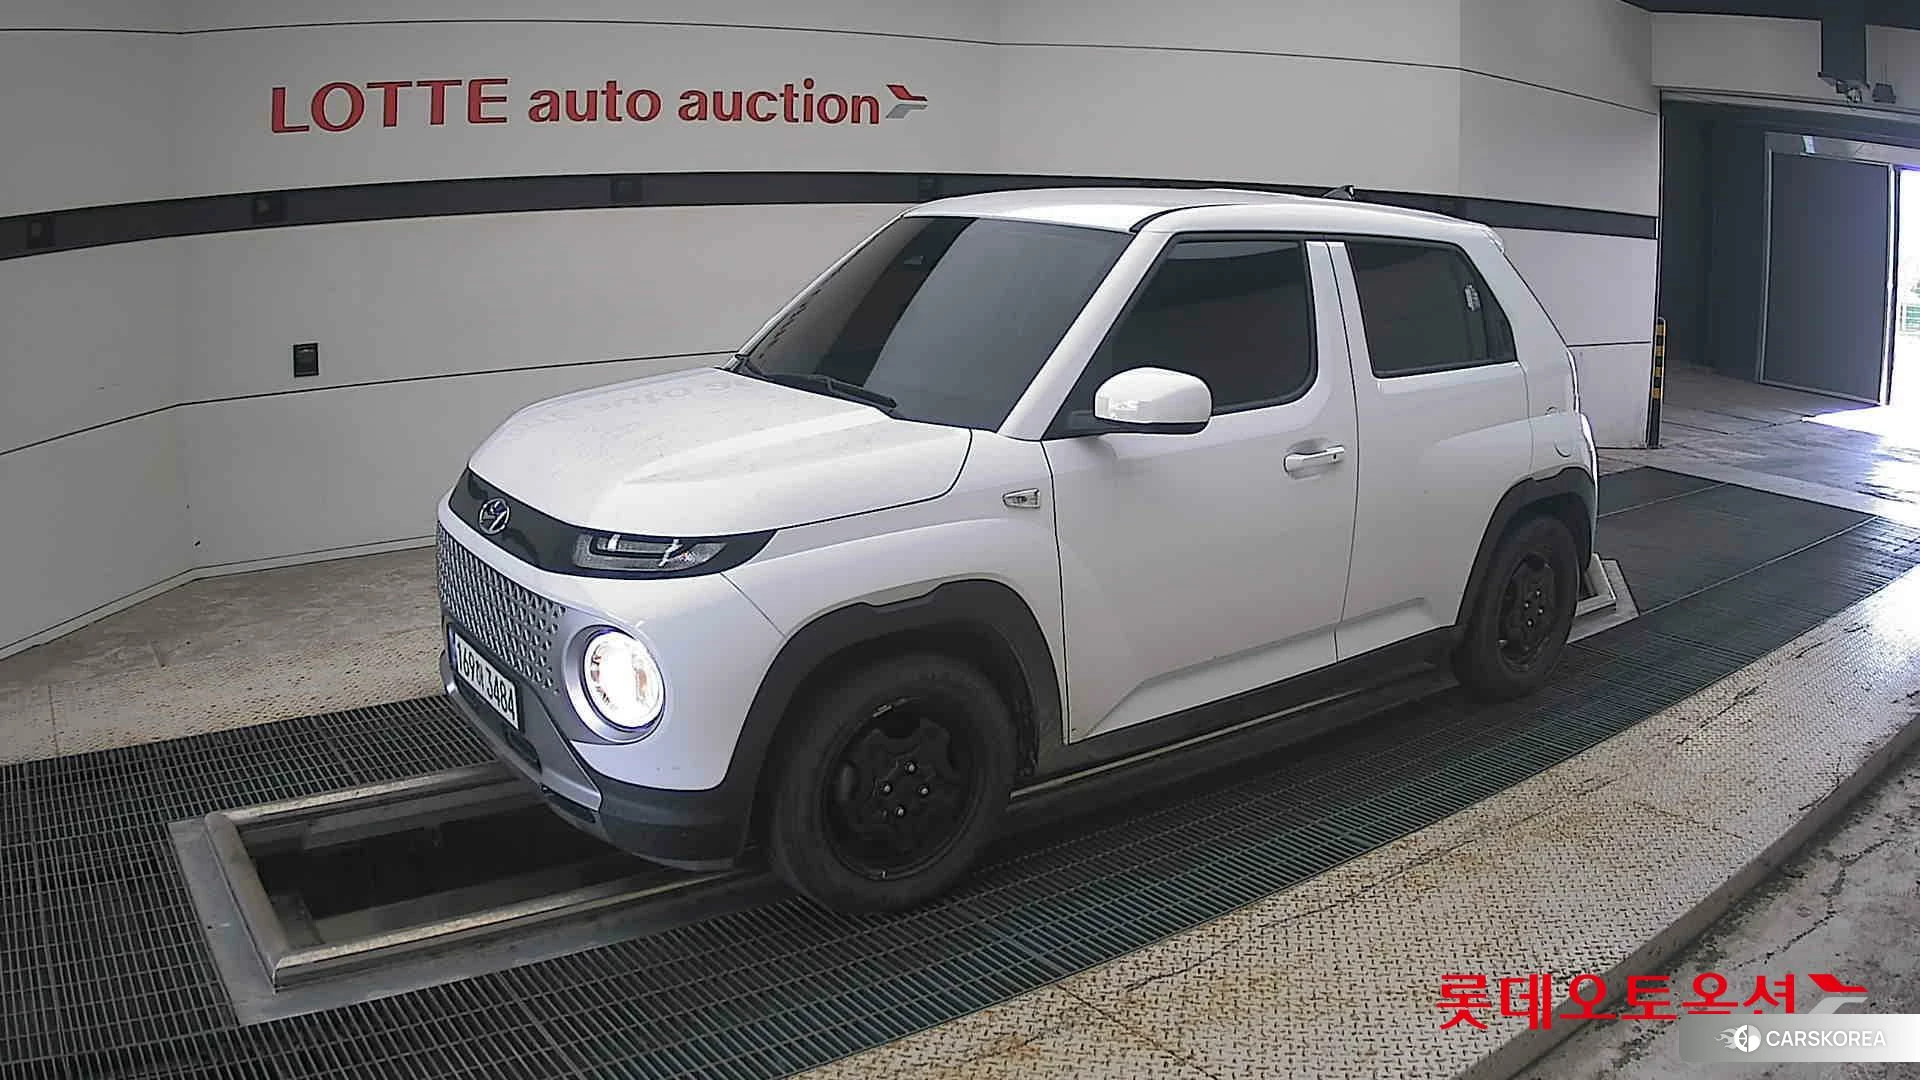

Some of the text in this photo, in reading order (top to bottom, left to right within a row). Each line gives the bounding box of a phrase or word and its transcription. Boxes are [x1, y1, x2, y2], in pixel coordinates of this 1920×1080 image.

[271, 77, 880, 133] LOTTE auto auction
[485, 667, 516, 720] 3484
